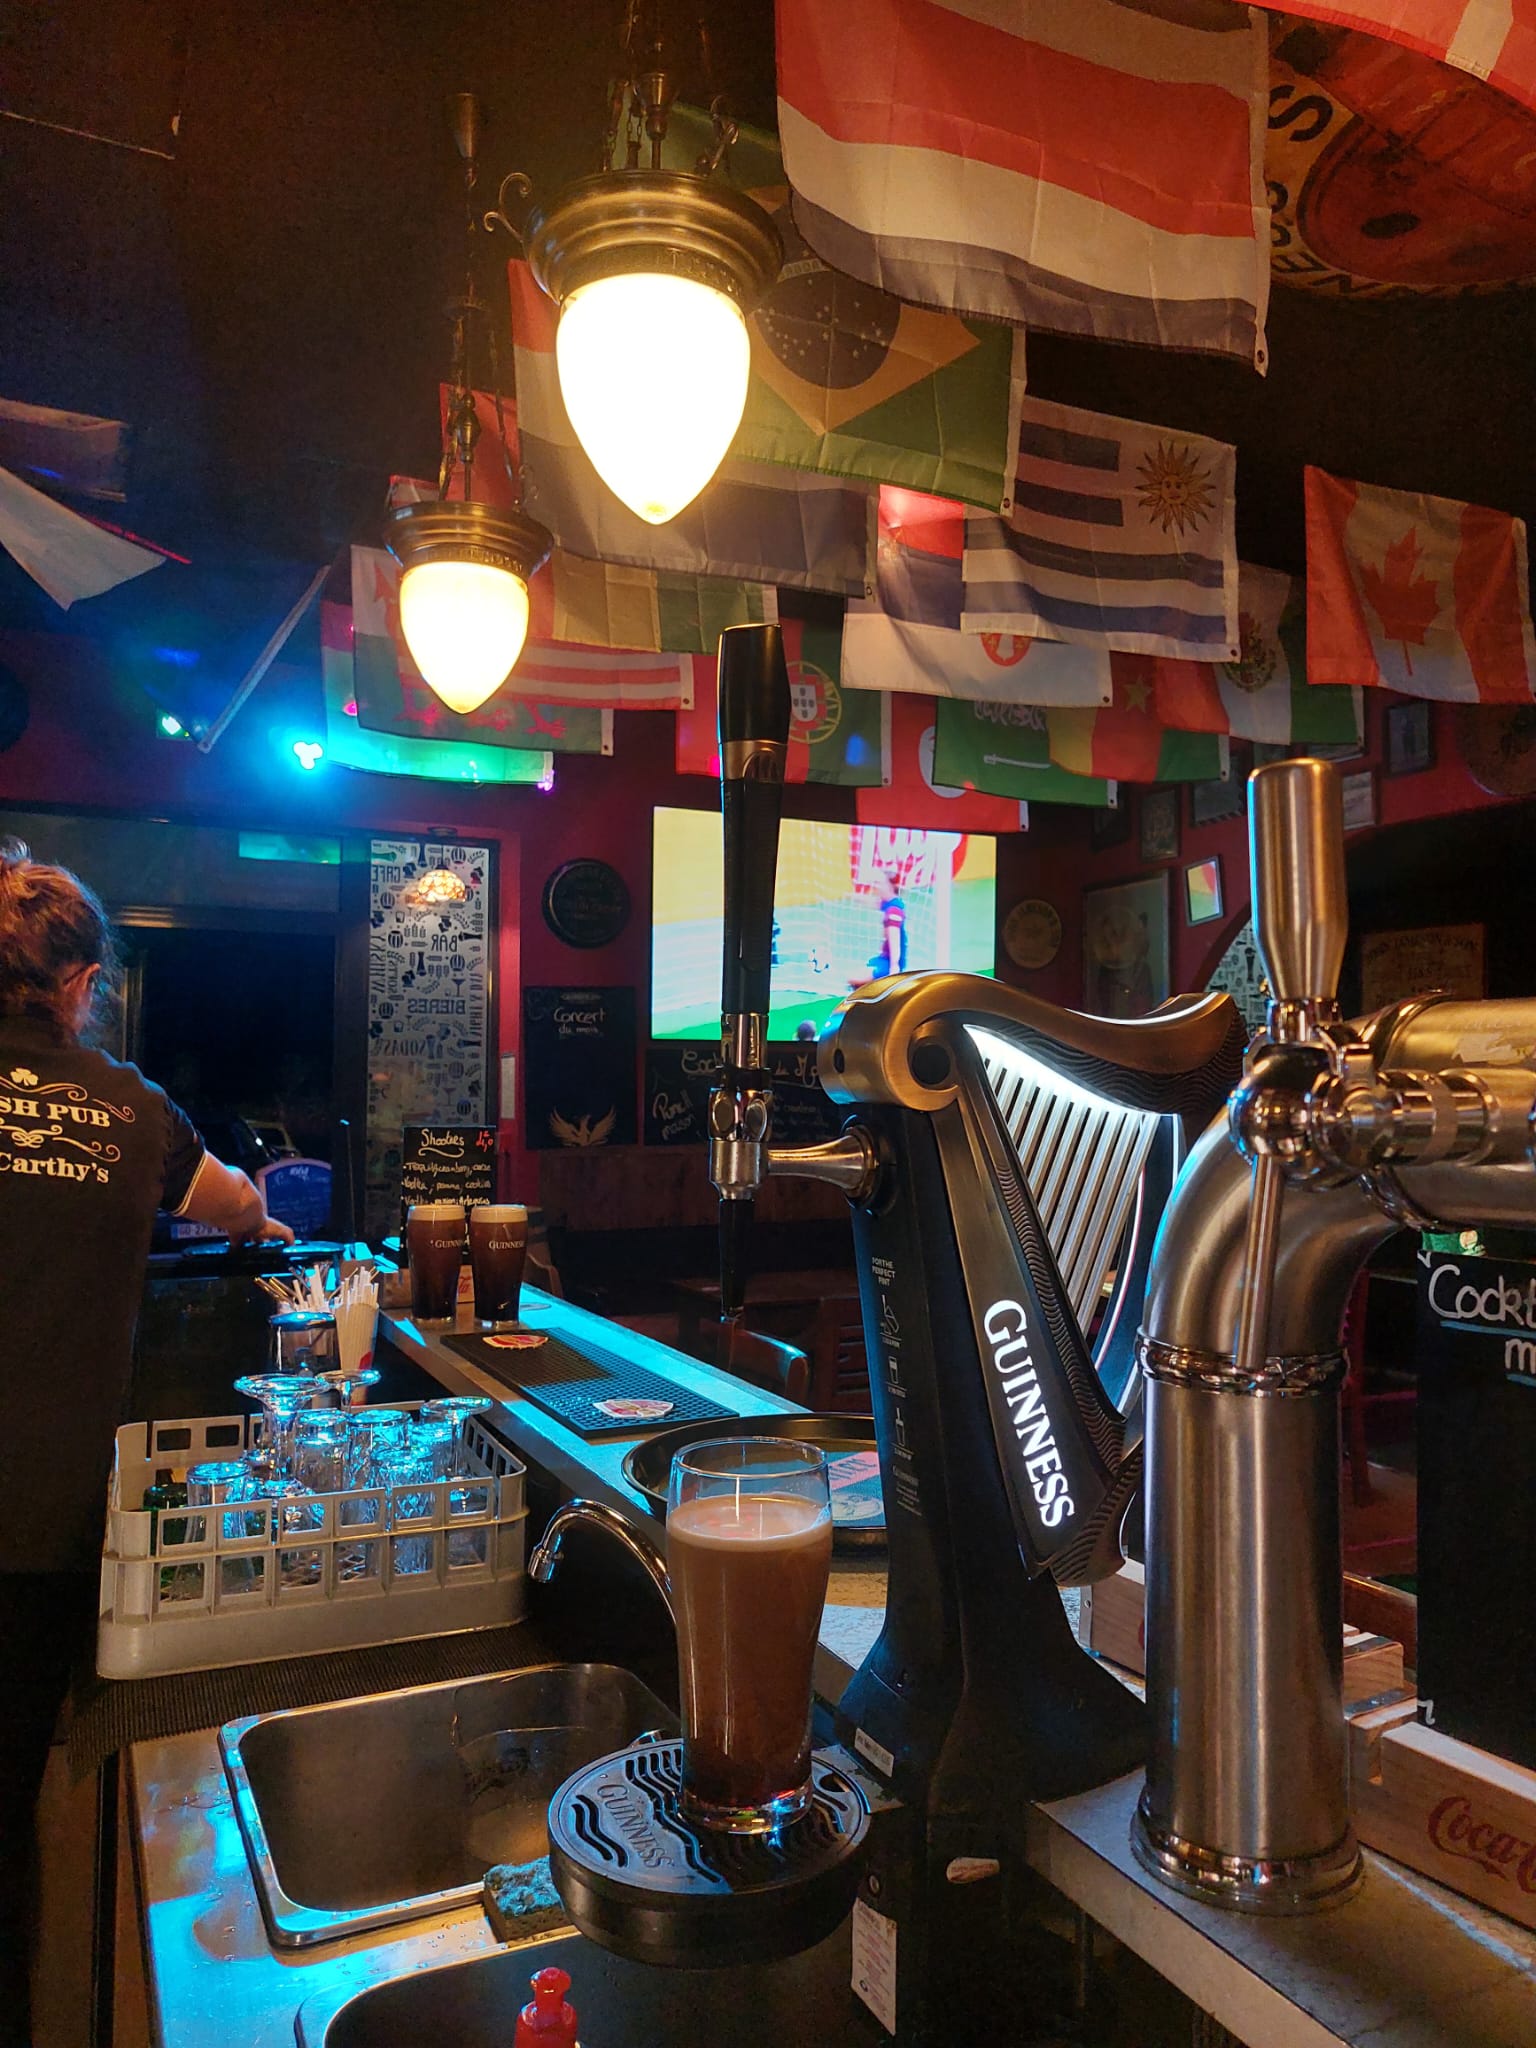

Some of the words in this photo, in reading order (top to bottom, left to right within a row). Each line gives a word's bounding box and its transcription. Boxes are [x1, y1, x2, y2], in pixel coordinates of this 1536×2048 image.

[553, 1007, 607, 1024] Concert
[46, 1103, 110, 1127] PUB
[984, 1299, 1075, 1528] GUINNESS
[597, 1783, 674, 1869] GUINNESS
